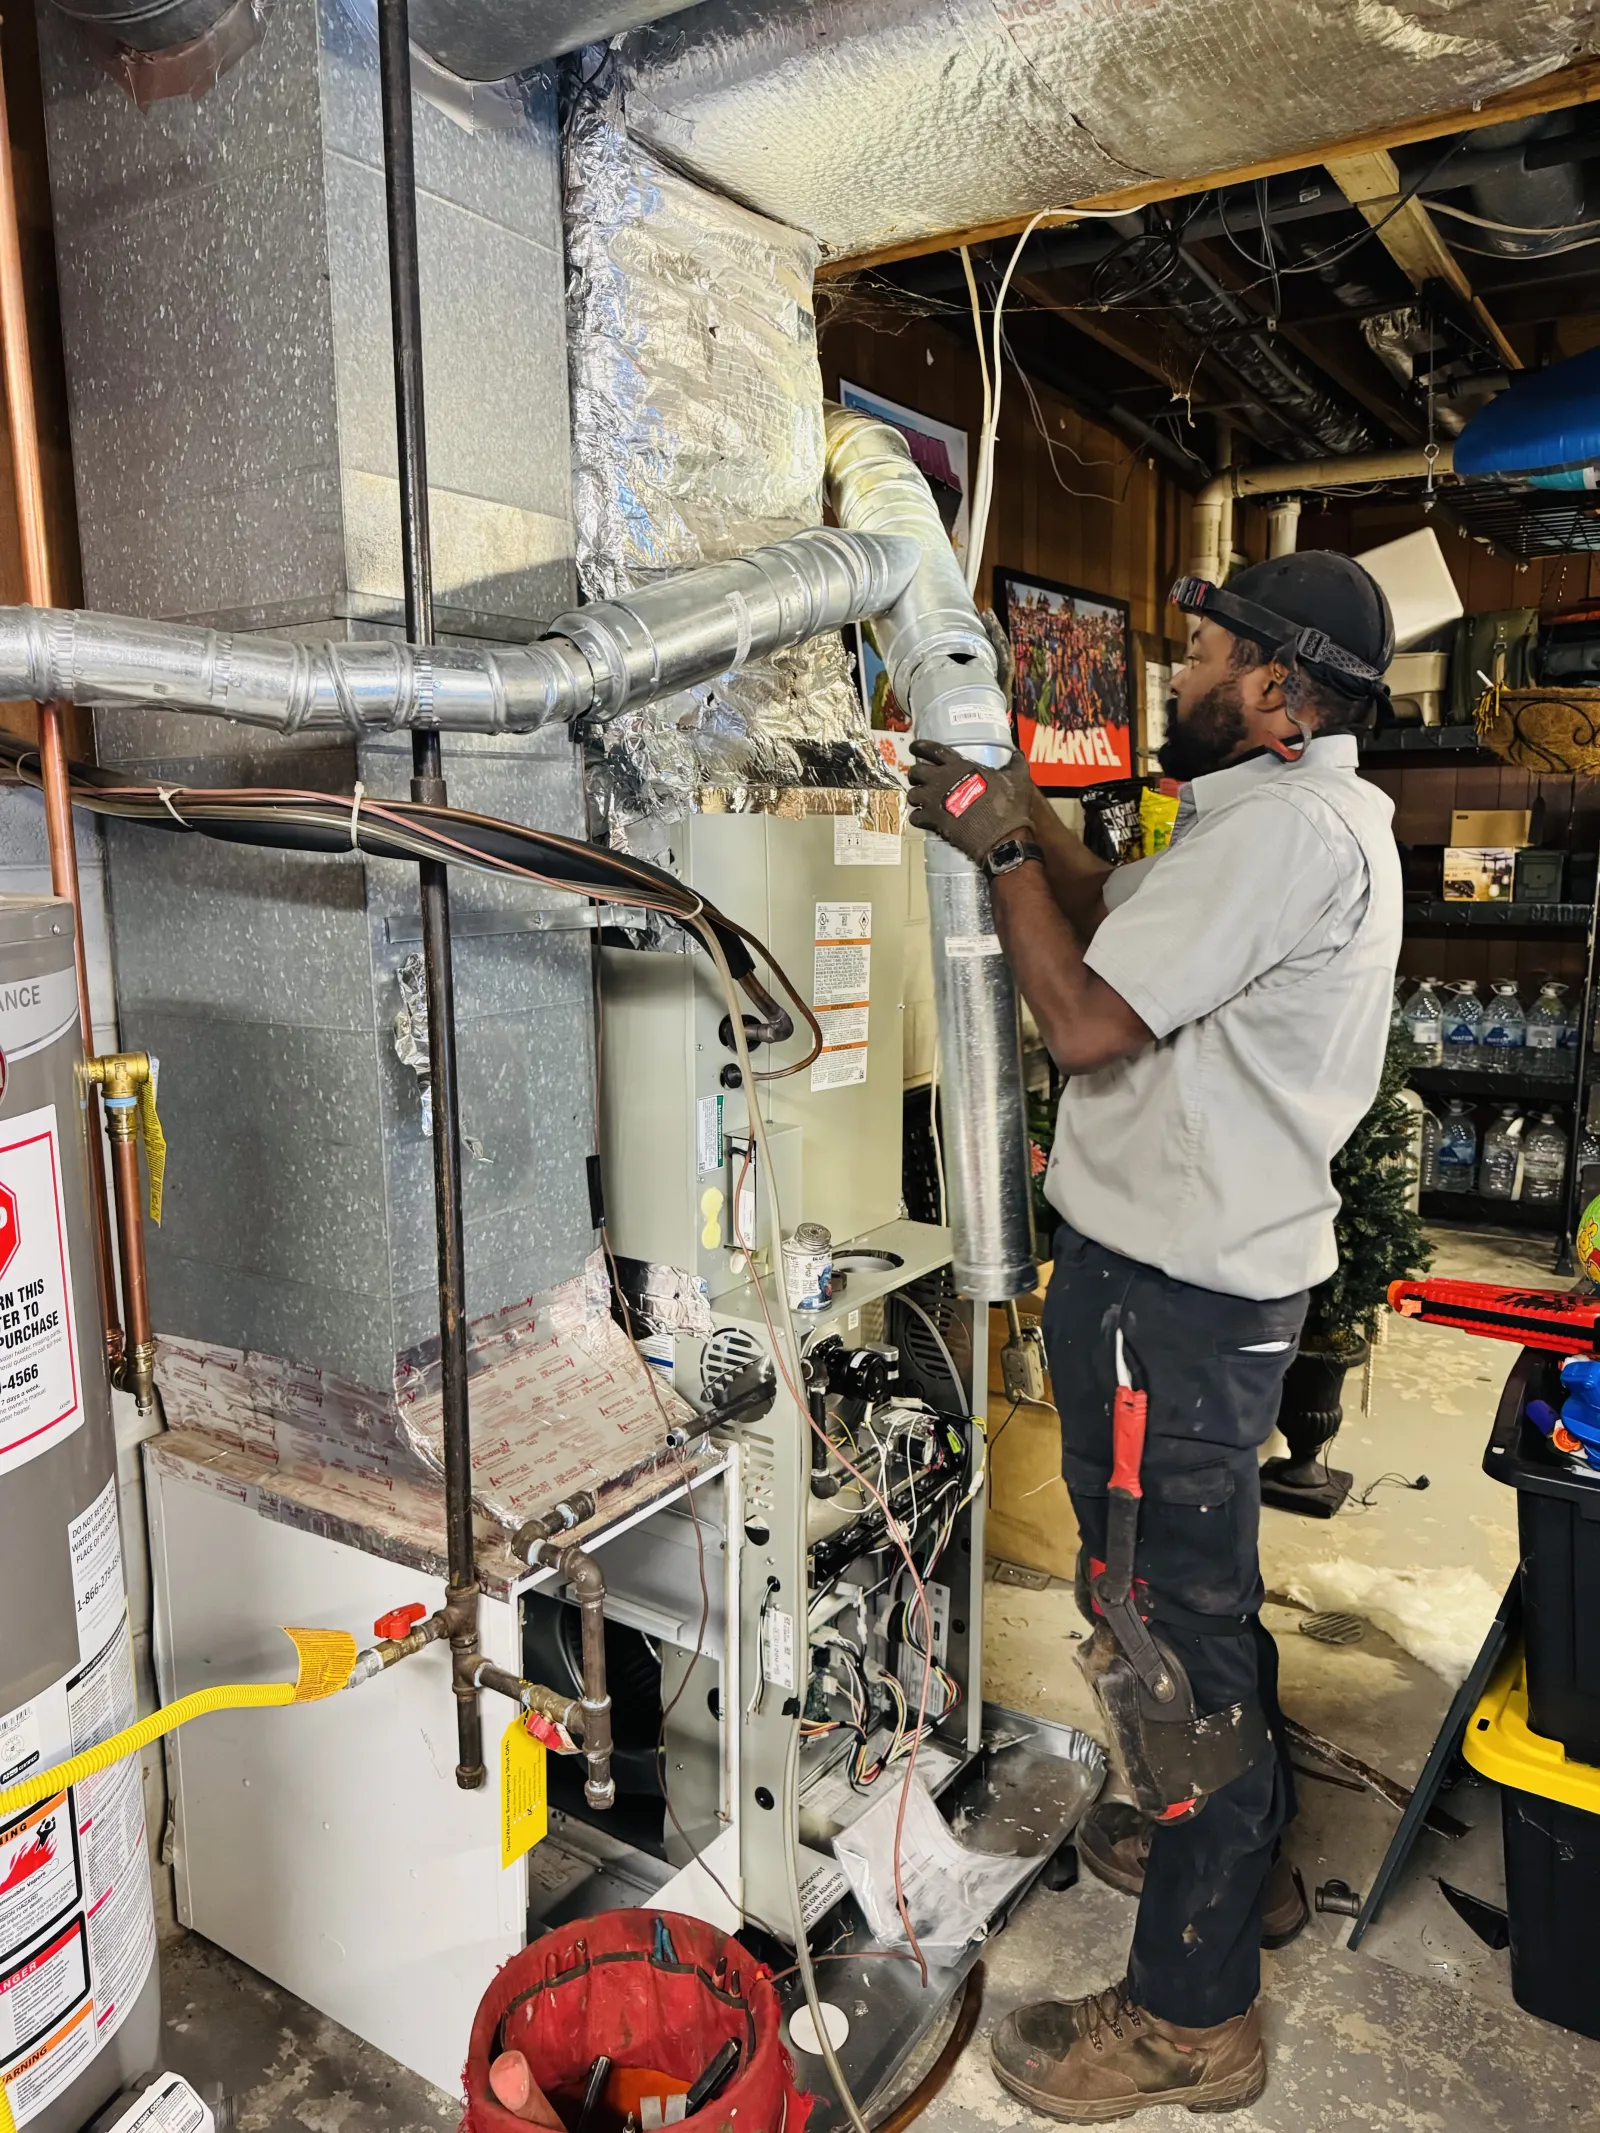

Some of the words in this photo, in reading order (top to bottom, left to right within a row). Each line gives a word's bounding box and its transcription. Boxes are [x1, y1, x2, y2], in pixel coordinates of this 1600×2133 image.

[1029, 722, 1122, 767] MARVEL
[17, 1278, 44, 1303] THIS
[23, 1301, 39, 1320] TO
[0, 1363, 39, 1395] -4566
[72, 1525, 82, 1538] DO
[83, 1513, 93, 1529] NOT
[72, 1531, 91, 1553] WATER
[76, 1543, 93, 1564] PLACE
[0, 1822, 27, 1846] ING
[801, 1893, 820, 1913] NFLOW
[819, 1872, 844, 1895] ADAPTER
[805, 1884, 819, 1896] USE
[0, 1961, 37, 1993] NGER
[3, 2045, 48, 2085] ARNING
[135, 2111, 151, 2128] LIGHT
[150, 2095, 165, 2113] CODE
